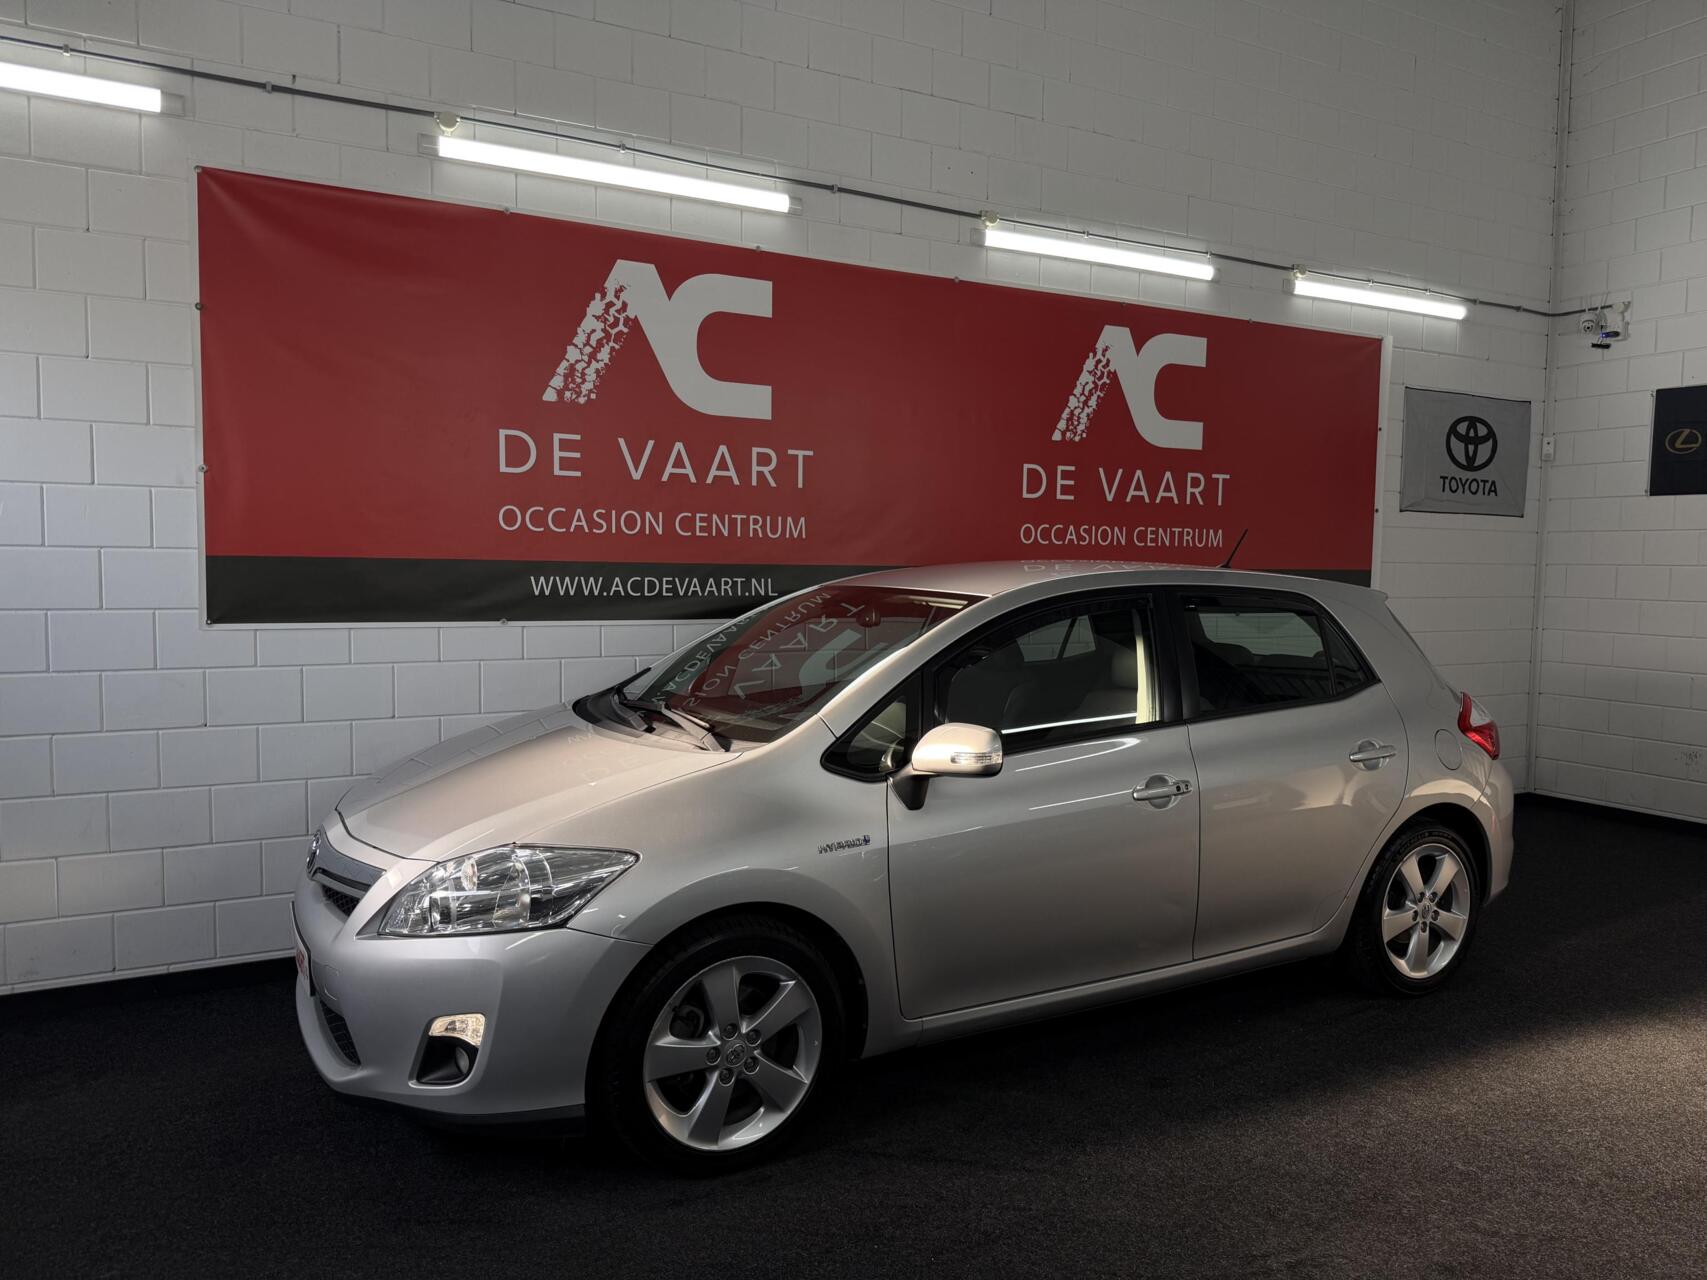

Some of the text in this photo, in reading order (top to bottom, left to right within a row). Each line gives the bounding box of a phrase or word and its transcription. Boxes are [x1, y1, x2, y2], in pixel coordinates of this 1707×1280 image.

[498, 428, 814, 489] DE VAART
[1022, 463, 1231, 506] DE VAART
[1440, 475, 1498, 497] TOYOTA
[498, 505, 807, 539] OCCASION CENTRUM
[1020, 523, 1223, 548] OCCASION CENTRUM
[530, 575, 778, 597] WWW.ACDEVAART.NL
